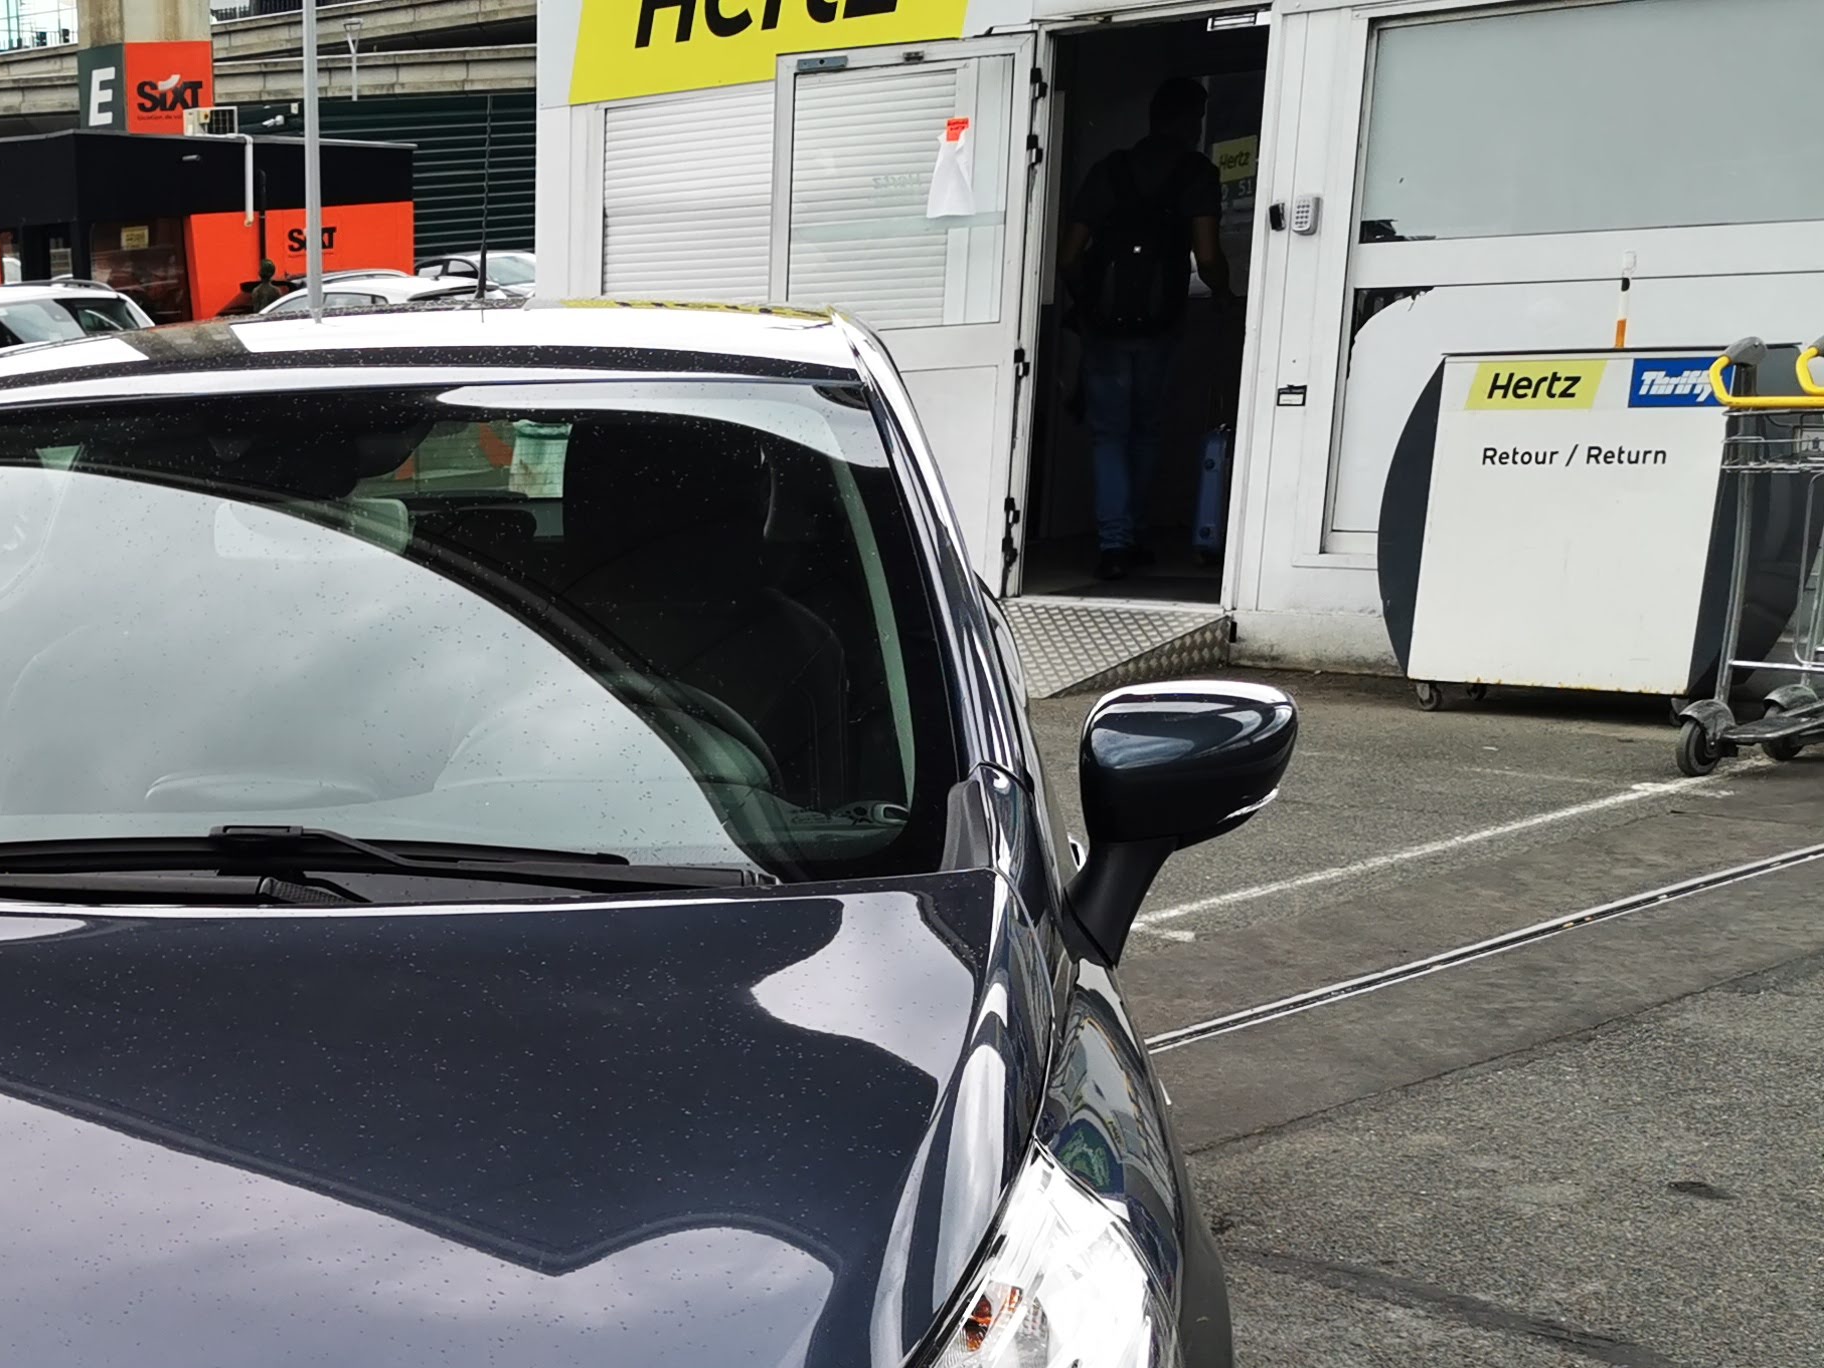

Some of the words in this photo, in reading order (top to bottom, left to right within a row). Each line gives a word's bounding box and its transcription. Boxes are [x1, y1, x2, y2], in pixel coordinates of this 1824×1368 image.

[89, 66, 116, 127] E
[1486, 371, 1582, 400] Hertz
[1481, 446, 1560, 466] Retour
[1585, 445, 1668, 466] Return
